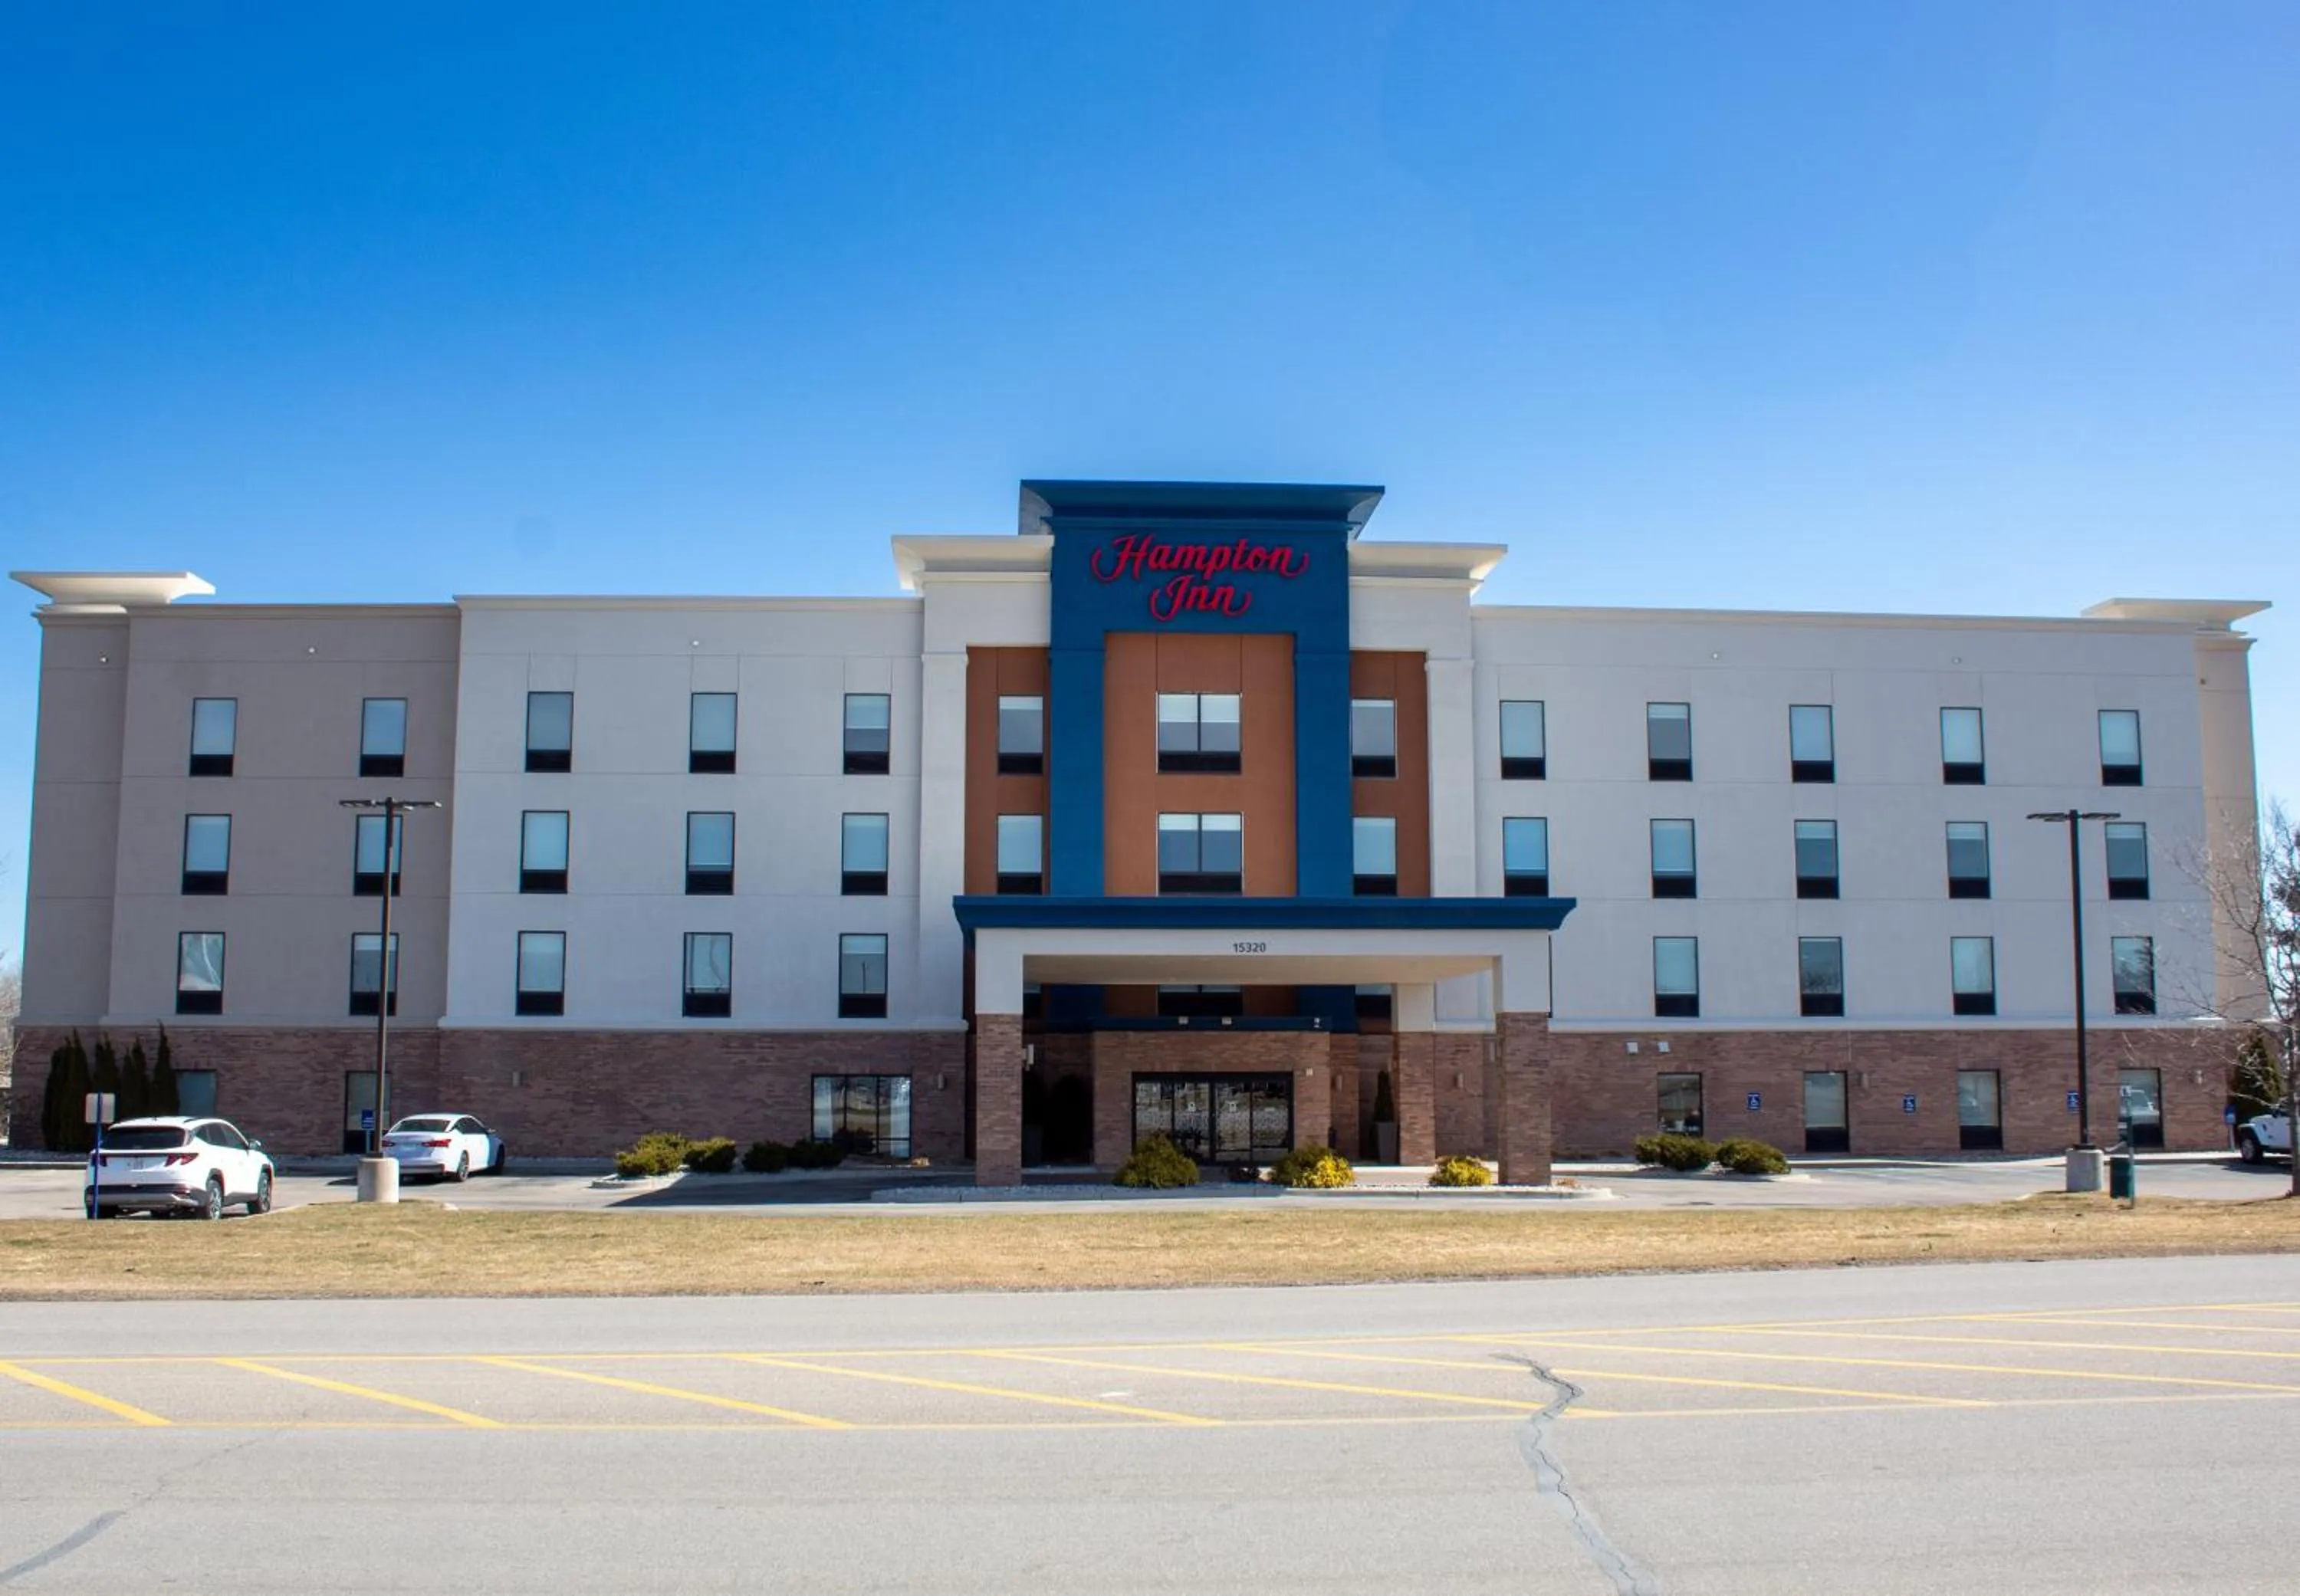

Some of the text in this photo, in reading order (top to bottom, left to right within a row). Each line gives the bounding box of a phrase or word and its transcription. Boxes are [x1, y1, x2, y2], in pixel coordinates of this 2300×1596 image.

[1091, 534, 1309, 581] Hampton
[1151, 574, 1252, 622] Inn
[1233, 942, 1266, 953] 15320
